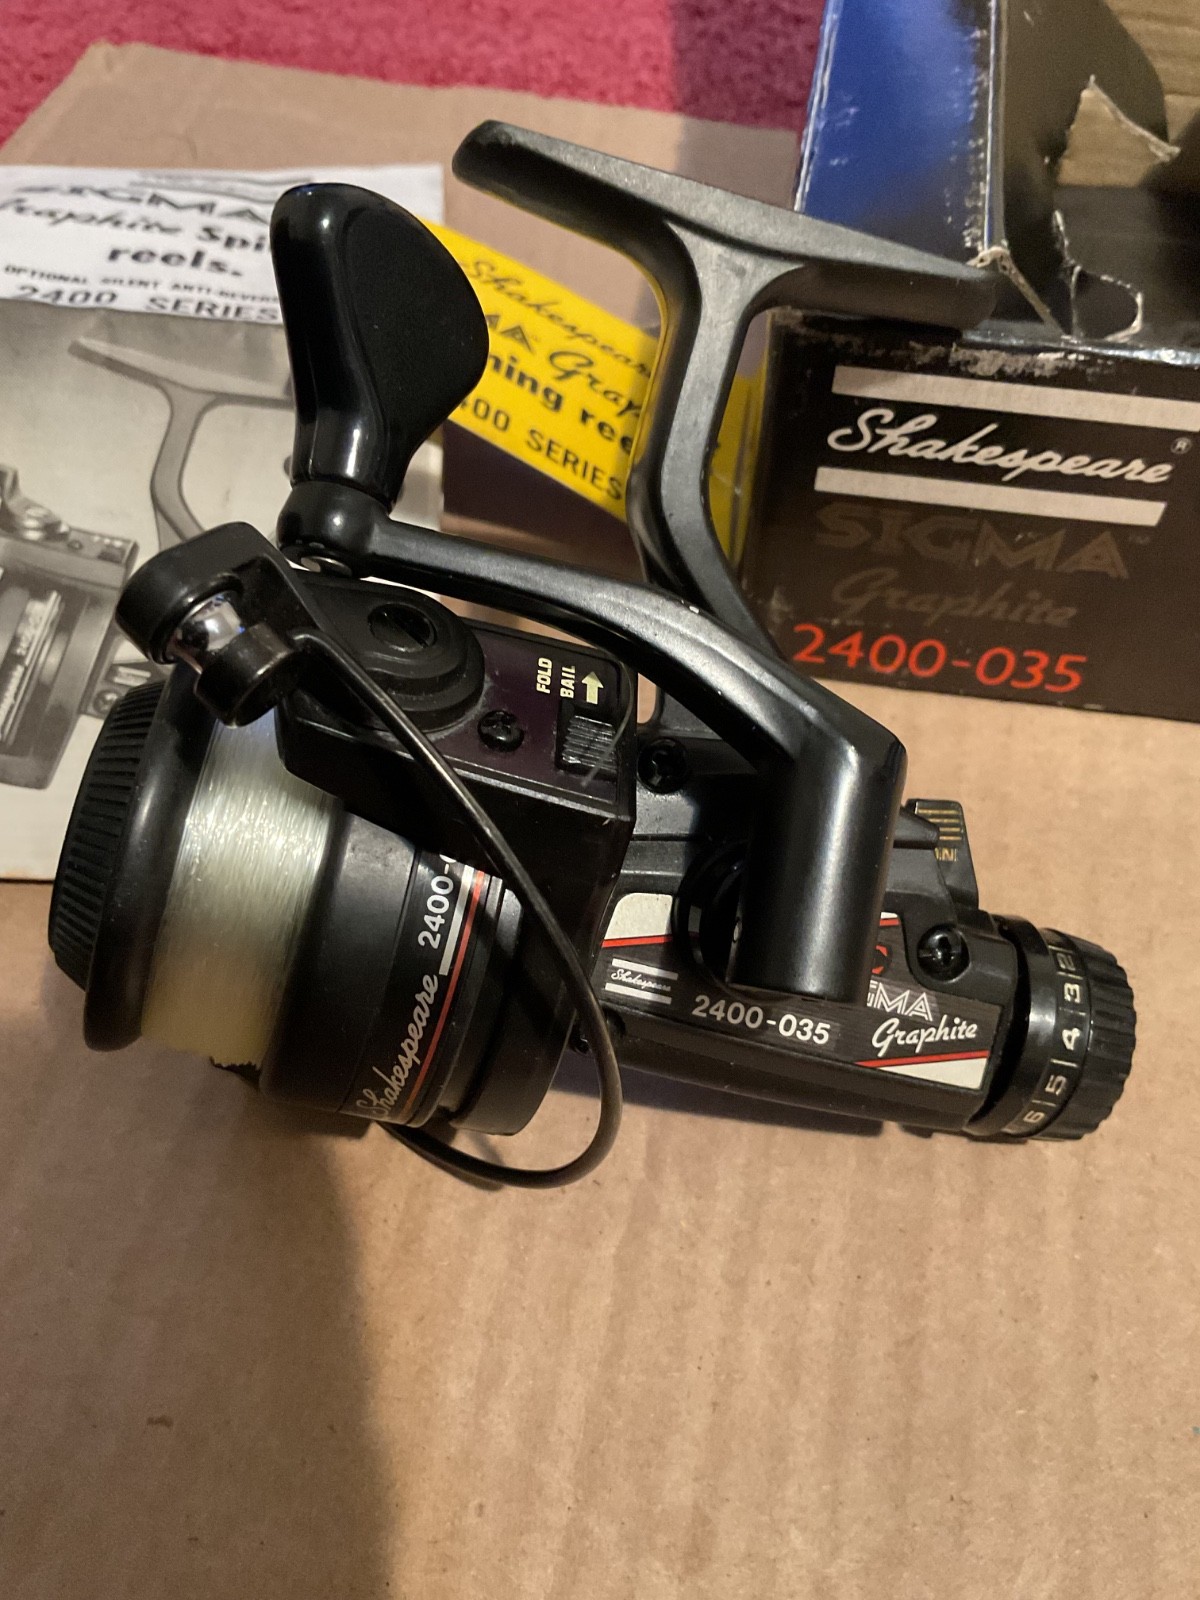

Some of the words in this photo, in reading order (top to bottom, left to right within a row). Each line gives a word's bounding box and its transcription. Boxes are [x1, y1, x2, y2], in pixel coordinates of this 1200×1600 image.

[107, 247, 243, 278] reels.
[197, 225, 268, 252] Spi
[17, 285, 118, 306] 2400
[145, 296, 280, 322] SERIES
[470, 259, 652, 380] Shakespear
[548, 350, 643, 420] Grap
[459, 397, 512, 434] 00
[525, 427, 626, 502] SERIES
[580, 407, 635, 458] ree
[827, 408, 1174, 484] Shakespeare
[814, 502, 1130, 580] SIGMA
[831, 566, 1078, 628] Graphite
[535, 656, 553, 695] FOLD
[559, 664, 577, 700] BAIL
[792, 622, 1089, 693] 2400-035
[1063, 982, 1082, 1004] 3
[691, 994, 832, 1045] 2400-035
[871, 1013, 979, 1058] Graphite
[1061, 1027, 1082, 1051] 4
[355, 974, 440, 1119] Shakespeare
[1044, 1074, 1068, 1096] 5
